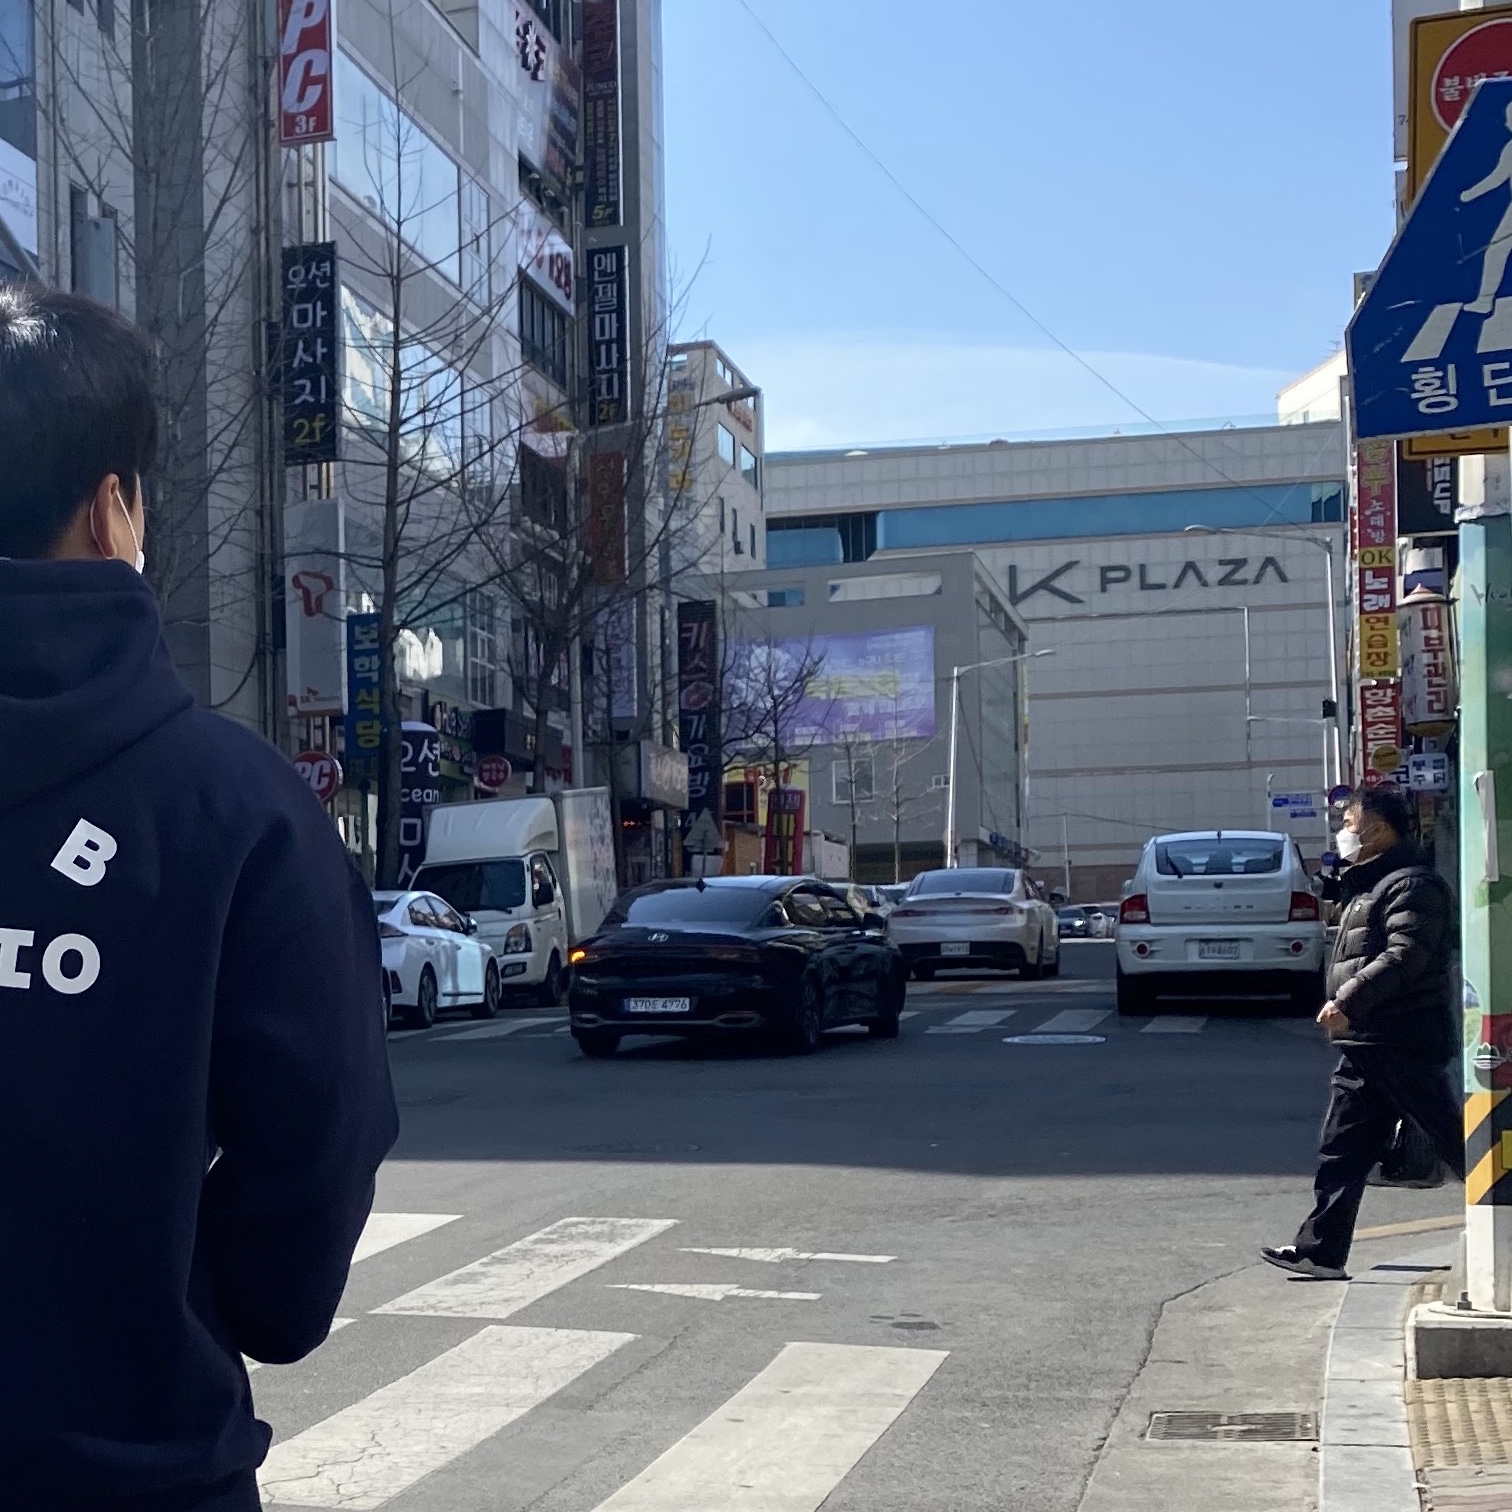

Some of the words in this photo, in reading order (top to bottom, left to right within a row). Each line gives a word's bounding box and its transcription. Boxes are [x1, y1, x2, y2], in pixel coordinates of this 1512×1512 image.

[295, 115, 317, 134] 3F
[1361, 550, 1393, 566] OK
[1100, 556, 1289, 593] PLAZA
[1365, 615, 1390, 667] 연습장
